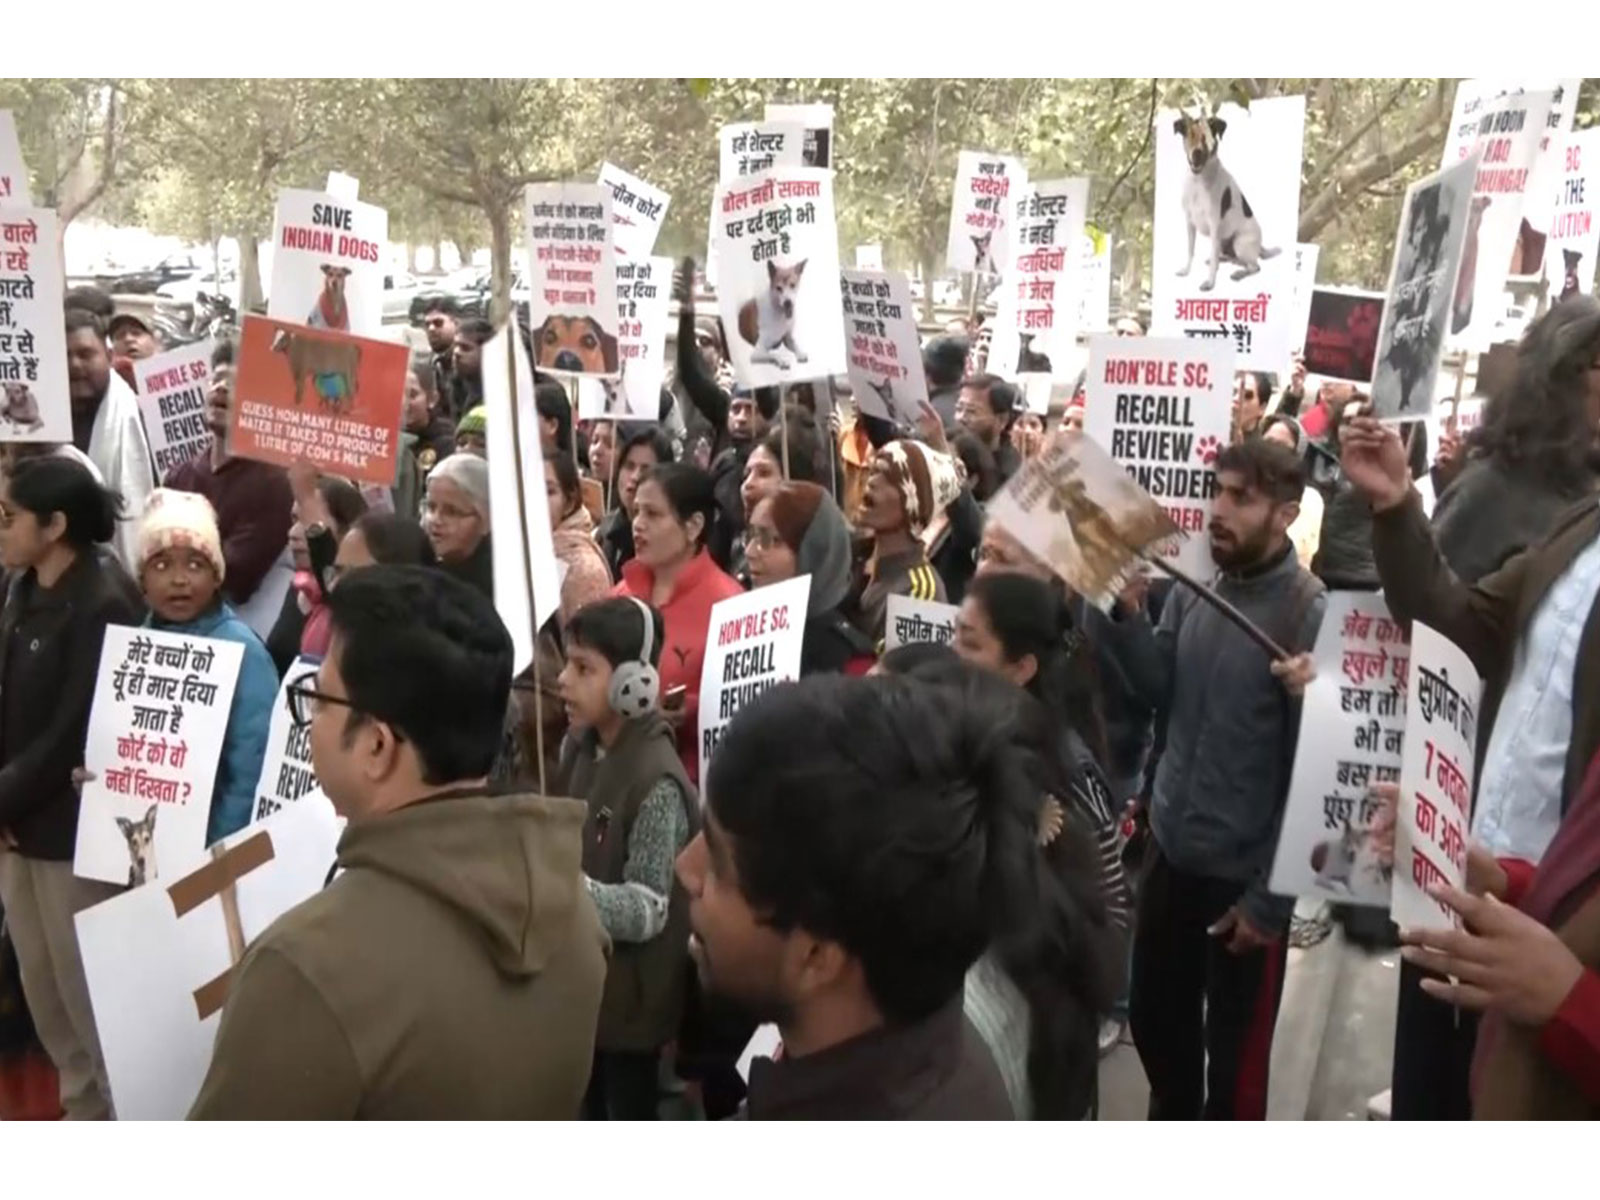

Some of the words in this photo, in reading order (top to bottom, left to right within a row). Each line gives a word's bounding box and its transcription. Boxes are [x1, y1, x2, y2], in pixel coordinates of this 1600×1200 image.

[749, 129, 785, 152] शेल्टर
[603, 179, 637, 208] प्रीम
[636, 195, 663, 222] कोर्ट
[748, 178, 777, 205] नहीं
[777, 181, 821, 198] सकता
[1029, 192, 1067, 217] शेल्टर
[3, 219, 38, 243] वाले
[312, 203, 352, 231] SAVE
[726, 220, 744, 239] पर
[765, 202, 792, 234] मुझे
[796, 202, 815, 224] भी
[1028, 218, 1059, 245] नहीं
[1552, 210, 1592, 239] LUTION
[7, 247, 29, 270] रहे
[282, 227, 333, 254] INDIAN
[338, 234, 379, 262] DOGS
[751, 239, 778, 261] होता
[779, 231, 791, 254] है
[633, 281, 657, 299] दिया
[875, 279, 891, 298] को
[1028, 275, 1055, 300] जेल
[876, 299, 902, 319] दिया
[1024, 303, 1053, 329] डालो
[1175, 298, 1230, 322] आवारा
[1232, 293, 1272, 323] नहीं
[16, 330, 34, 354] से
[25, 356, 39, 381] हैं
[1104, 359, 1178, 387] HON'BLE
[1184, 362, 1213, 391] SC,
[241, 400, 274, 419] GUESS
[275, 407, 300, 424] HOW
[301, 411, 333, 429] MANY
[334, 418, 371, 438] LITRES
[374, 427, 390, 442] OF
[1116, 393, 1194, 426] RECALL
[238, 415, 273, 433] WATER
[273, 421, 283, 436] IT
[285, 424, 319, 444] TAKES
[321, 431, 336, 446] TO
[336, 435, 389, 458] PRODUCE
[261, 435, 288, 453] LITRE
[291, 441, 303, 455] OF
[306, 444, 340, 462] COW'S
[343, 451, 369, 468] MILK
[1111, 429, 1194, 463] REVIEW
[1167, 507, 1204, 532] DER
[718, 609, 768, 646] HON'BLE
[771, 605, 790, 630] SC,
[895, 614, 933, 642] सुप्रीम
[127, 635, 154, 664] मेरे
[154, 642, 193, 670] बच्चों
[192, 643, 215, 673] को
[723, 642, 775, 684] RECALL
[1343, 648, 1388, 685] खुले
[113, 659, 128, 702] यूँ
[128, 666, 146, 696] ही
[146, 674, 180, 701] मार
[181, 675, 218, 707] दिया
[1418, 664, 1459, 732] सुप्रीम
[1339, 686, 1373, 714] हम
[1377, 686, 1400, 716] तो
[132, 705, 168, 733] जाता
[169, 704, 184, 734] है
[117, 732, 146, 761] कोर्ट
[147, 737, 168, 766] को
[169, 740, 188, 769] वो
[1355, 720, 1381, 752] भी
[1336, 760, 1372, 787] बस
[1425, 740, 1435, 780] 7
[105, 766, 135, 795] नहीं
[134, 769, 181, 804] दिखता
[181, 782, 192, 805] ?
[1415, 792, 1438, 842] का
